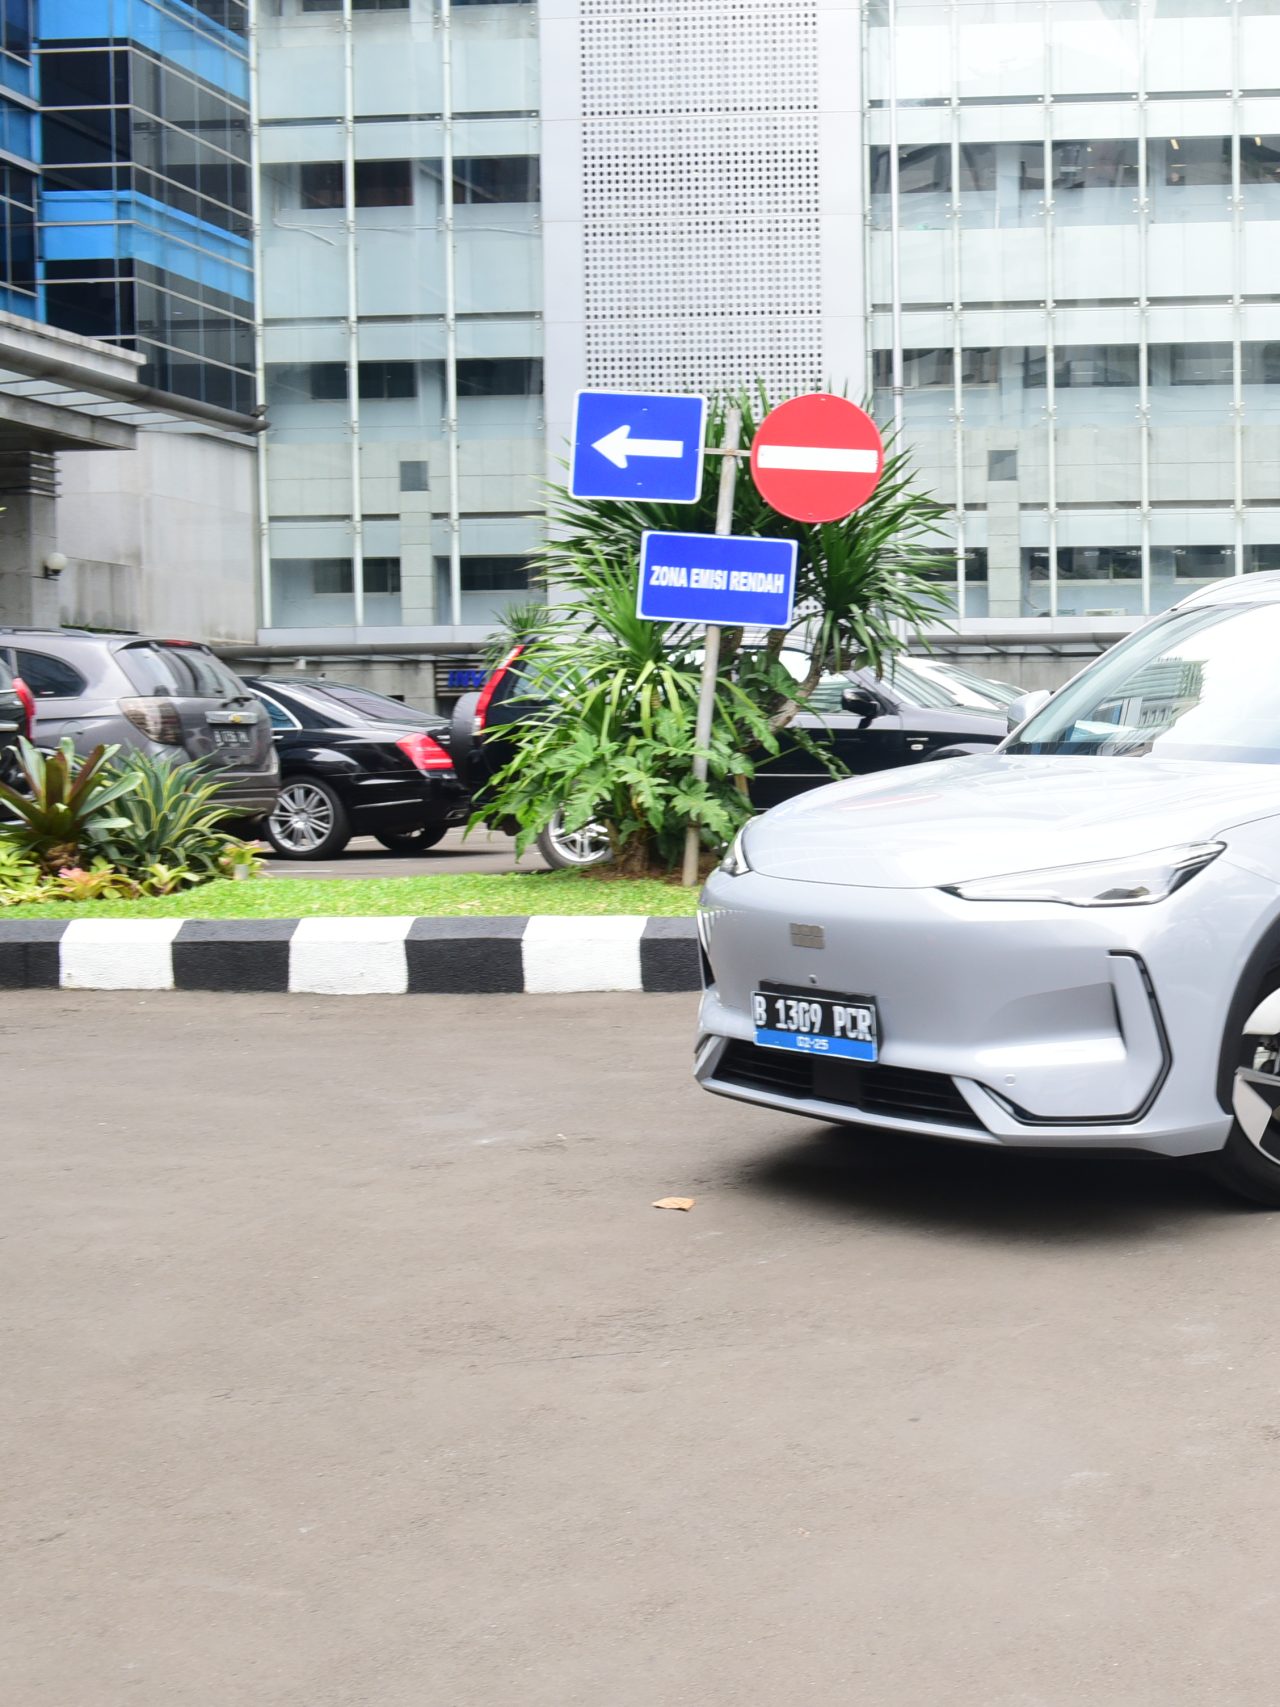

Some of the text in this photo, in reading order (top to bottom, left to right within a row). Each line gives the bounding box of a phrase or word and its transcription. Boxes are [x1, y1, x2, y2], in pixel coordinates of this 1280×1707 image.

[649, 565, 785, 594] ZONA EMISI RENDAH
[753, 995, 873, 1041] B 1309 PCR
